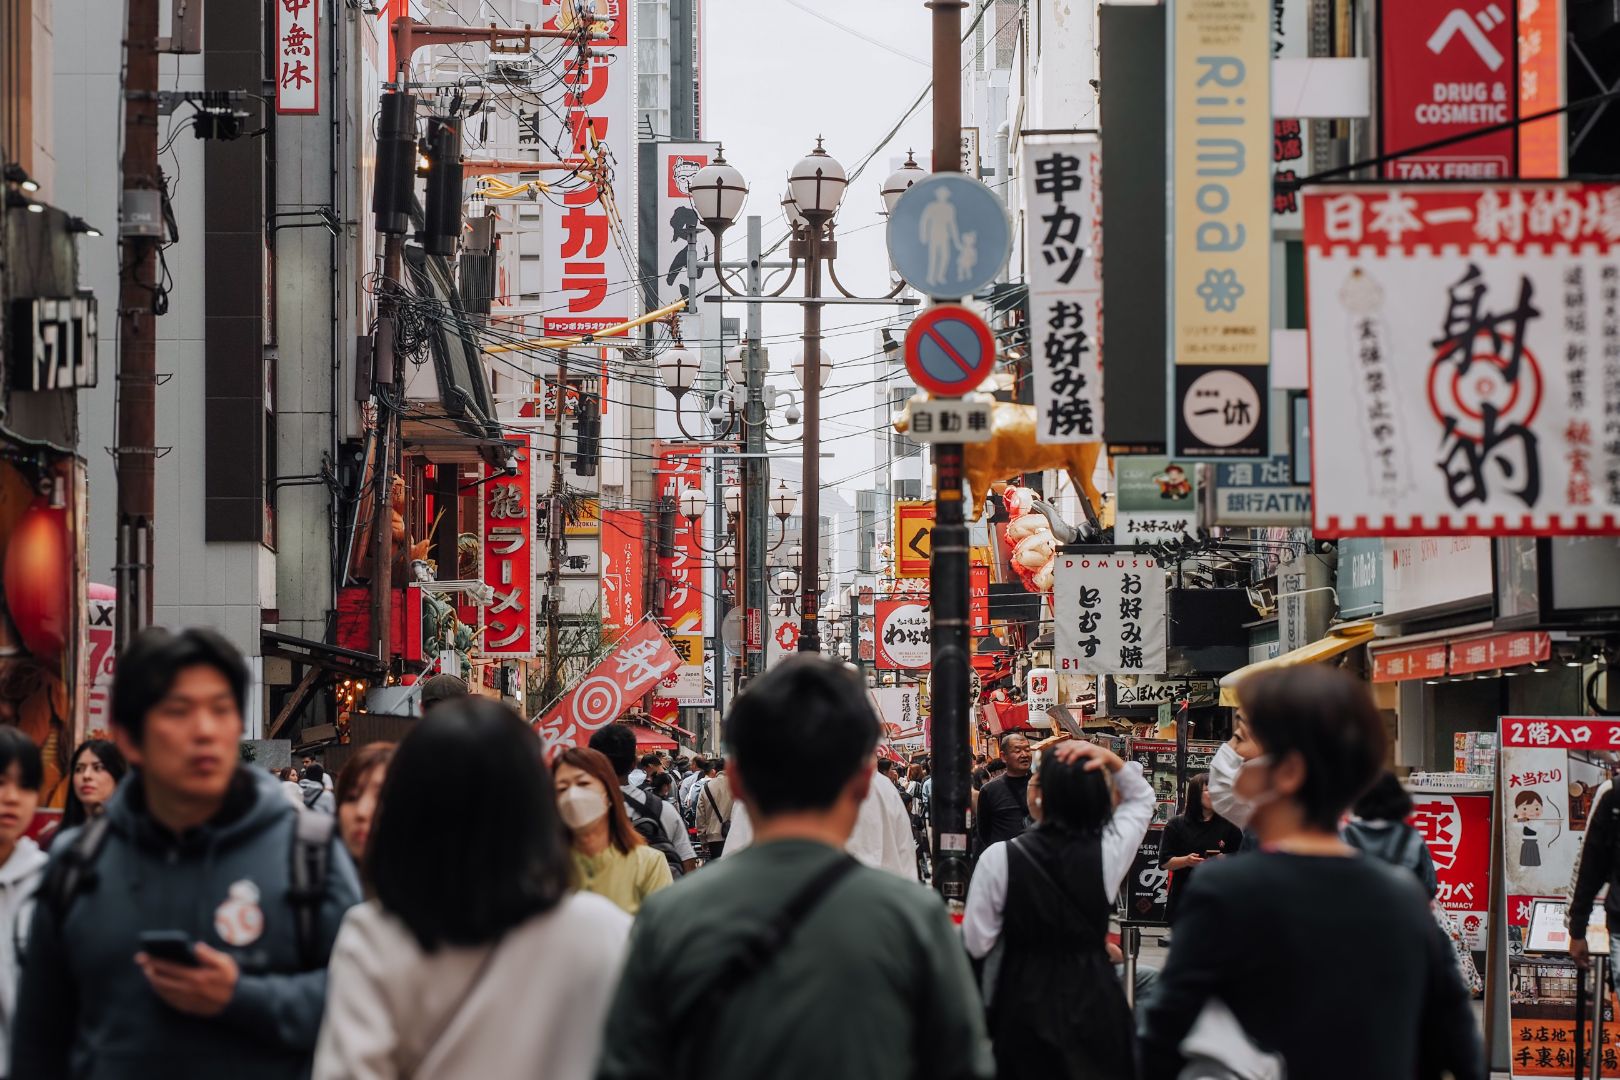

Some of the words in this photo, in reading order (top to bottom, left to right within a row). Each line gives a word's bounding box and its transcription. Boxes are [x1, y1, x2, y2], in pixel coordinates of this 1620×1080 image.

[1426, 3, 1505, 72] ベ
[1433, 82, 1488, 102] DRUG
[1491, 81, 1506, 102] &
[1415, 103, 1507, 124] COSMETIC
[1397, 163, 1440, 179] TAX
[1443, 163, 1499, 179] FREE
[1035, 153, 1084, 285] 串カツ
[1044, 301, 1093, 436] お好み焼
[1432, 263, 1541, 508] 射的
[911, 411, 989, 433] 自動車
[1193, 399, 1251, 425] 一休
[1228, 462, 1253, 486] 酒
[1227, 493, 1312, 513] 銀行ATM
[667, 454, 692, 609] ツルドラッグ
[1127, 519, 1188, 534] お好み焼
[1065, 559, 1155, 569] DOMUSU
[1119, 572, 1143, 669] お好み焼
[1061, 658, 1079, 670] B1
[1510, 722, 1592, 745] 2階入口
[1508, 768, 1562, 788] 大当たり
[1441, 902, 1474, 910] ARMACY
[1514, 1047, 1618, 1070] 手裏剣場
